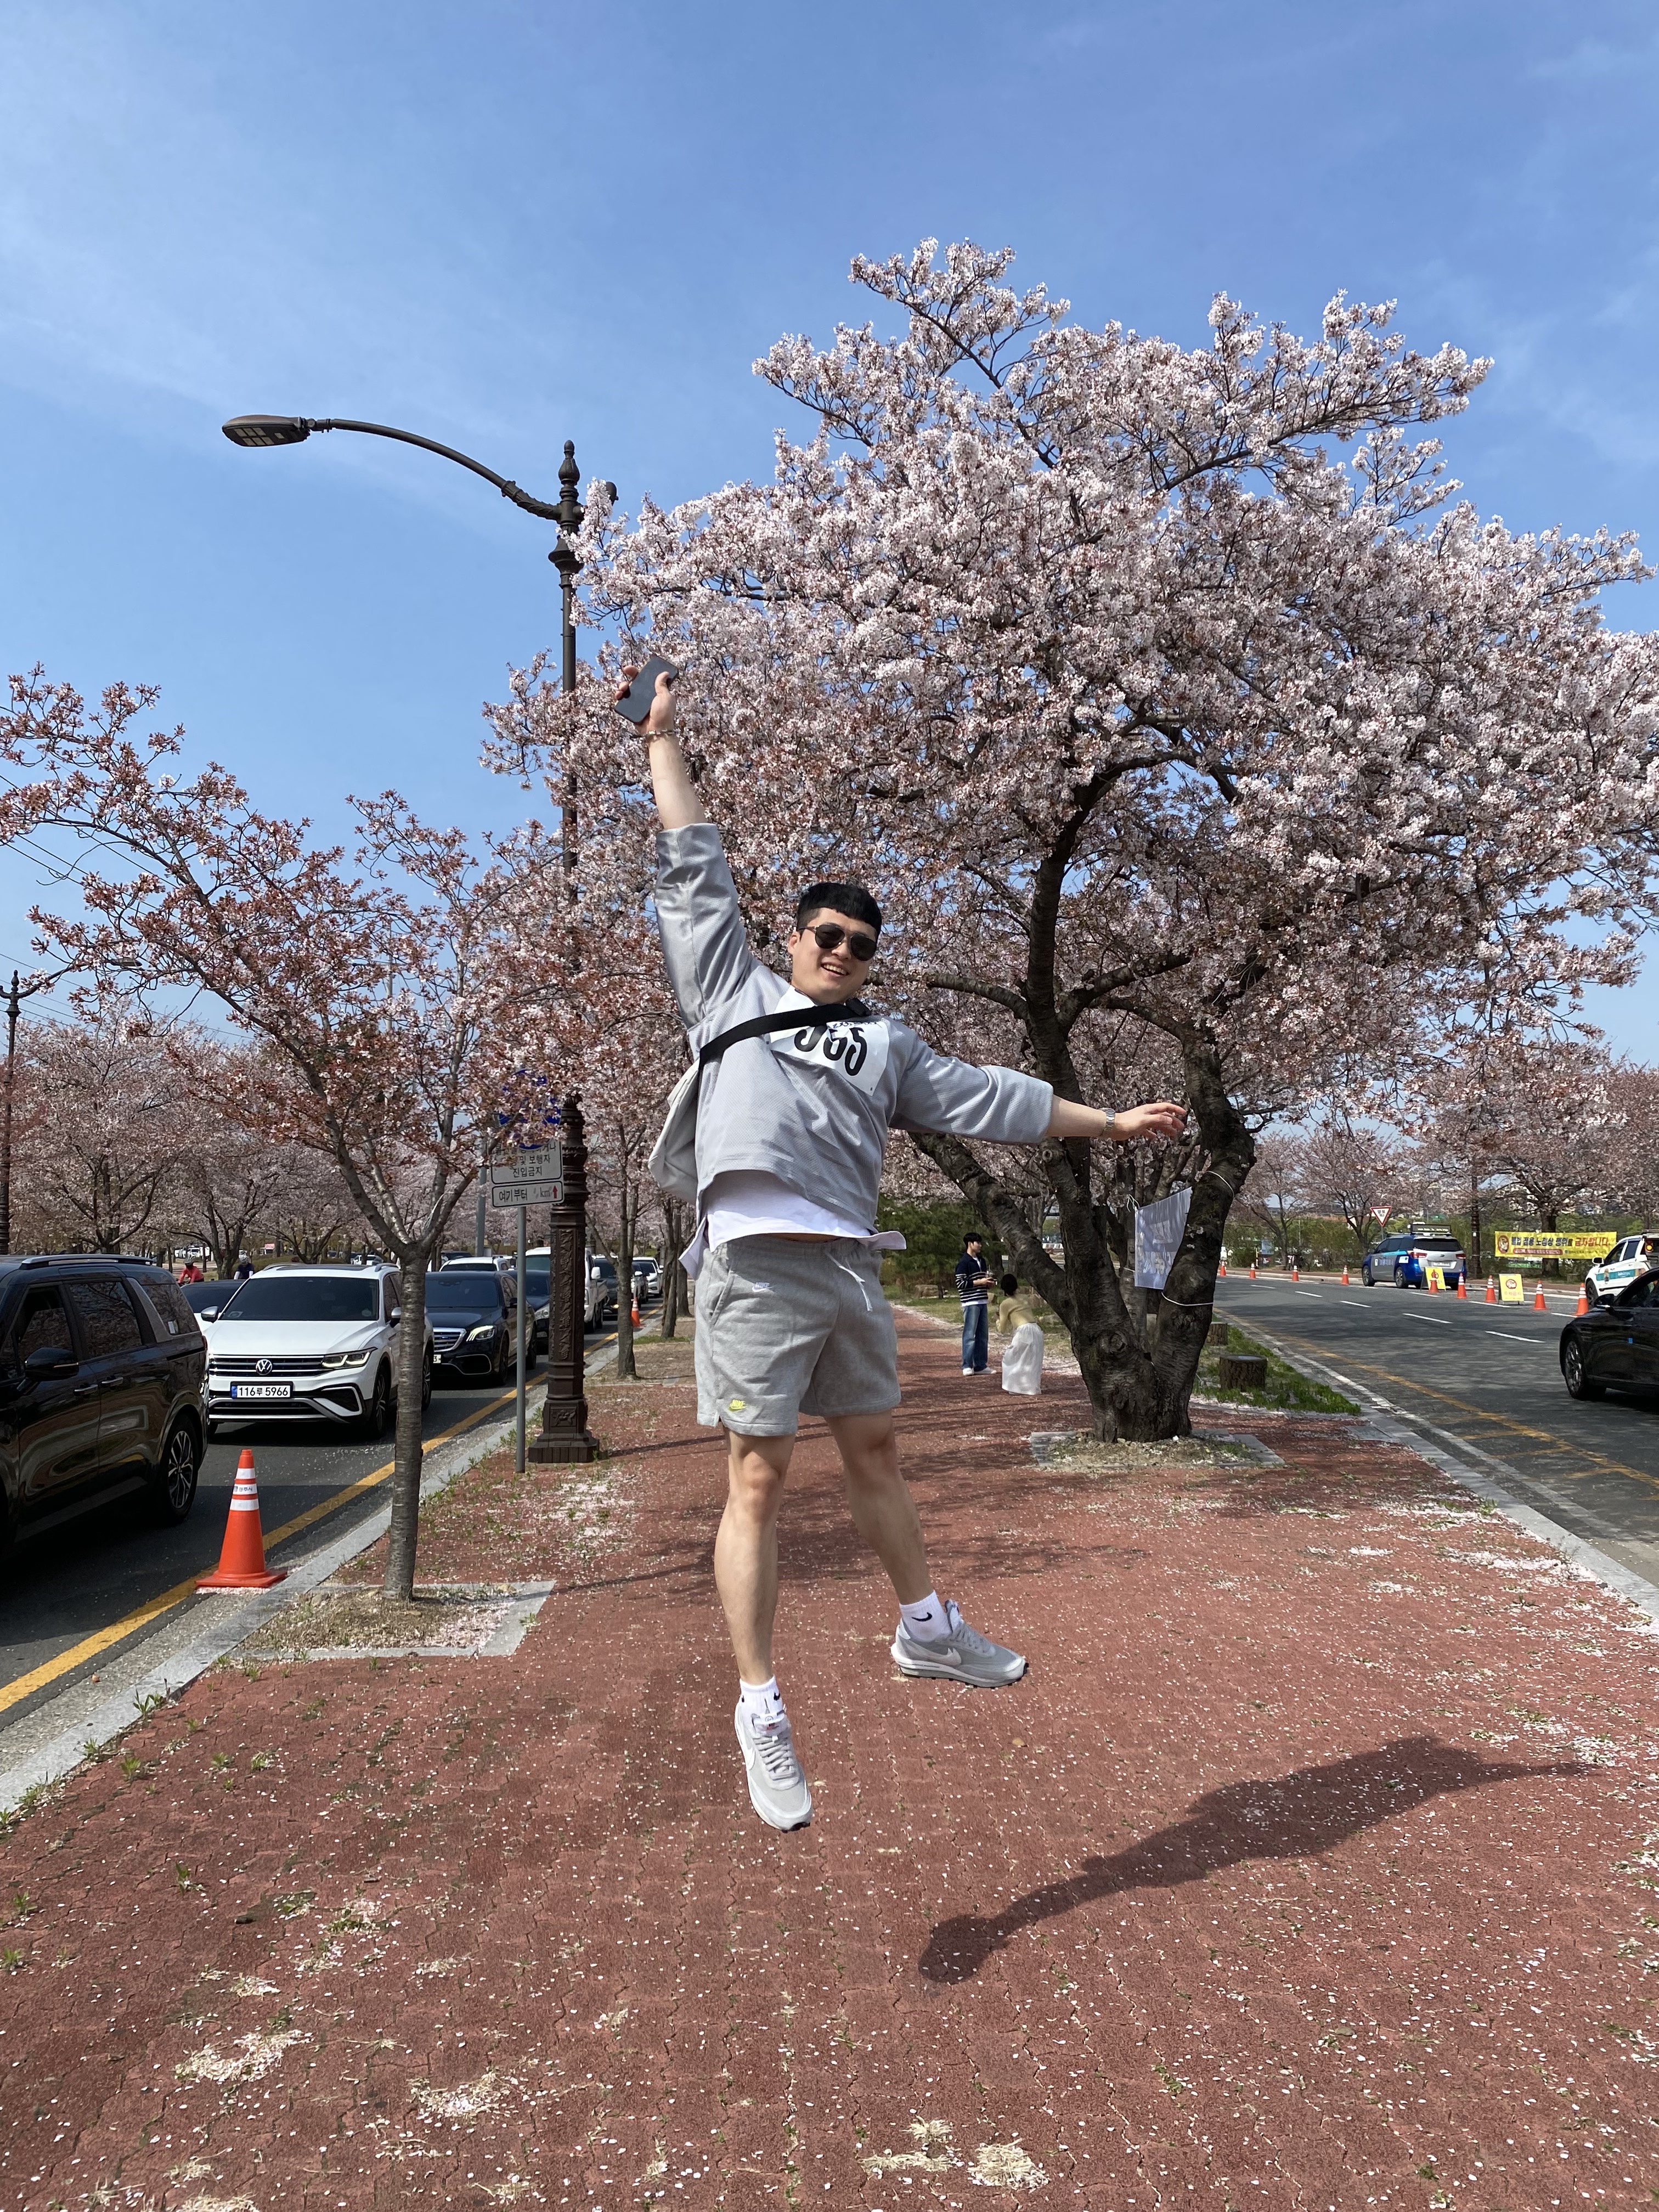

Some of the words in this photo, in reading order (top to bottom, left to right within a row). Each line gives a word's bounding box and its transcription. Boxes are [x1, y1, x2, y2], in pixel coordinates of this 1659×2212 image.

[529, 1154, 550, 1165] 보행자
[513, 1165, 543, 1178] 진입금지
[499, 1187, 528, 1203] 여기부터
[540, 1187, 551, 1198] km
[731, 1399, 746, 1408] NIKE
